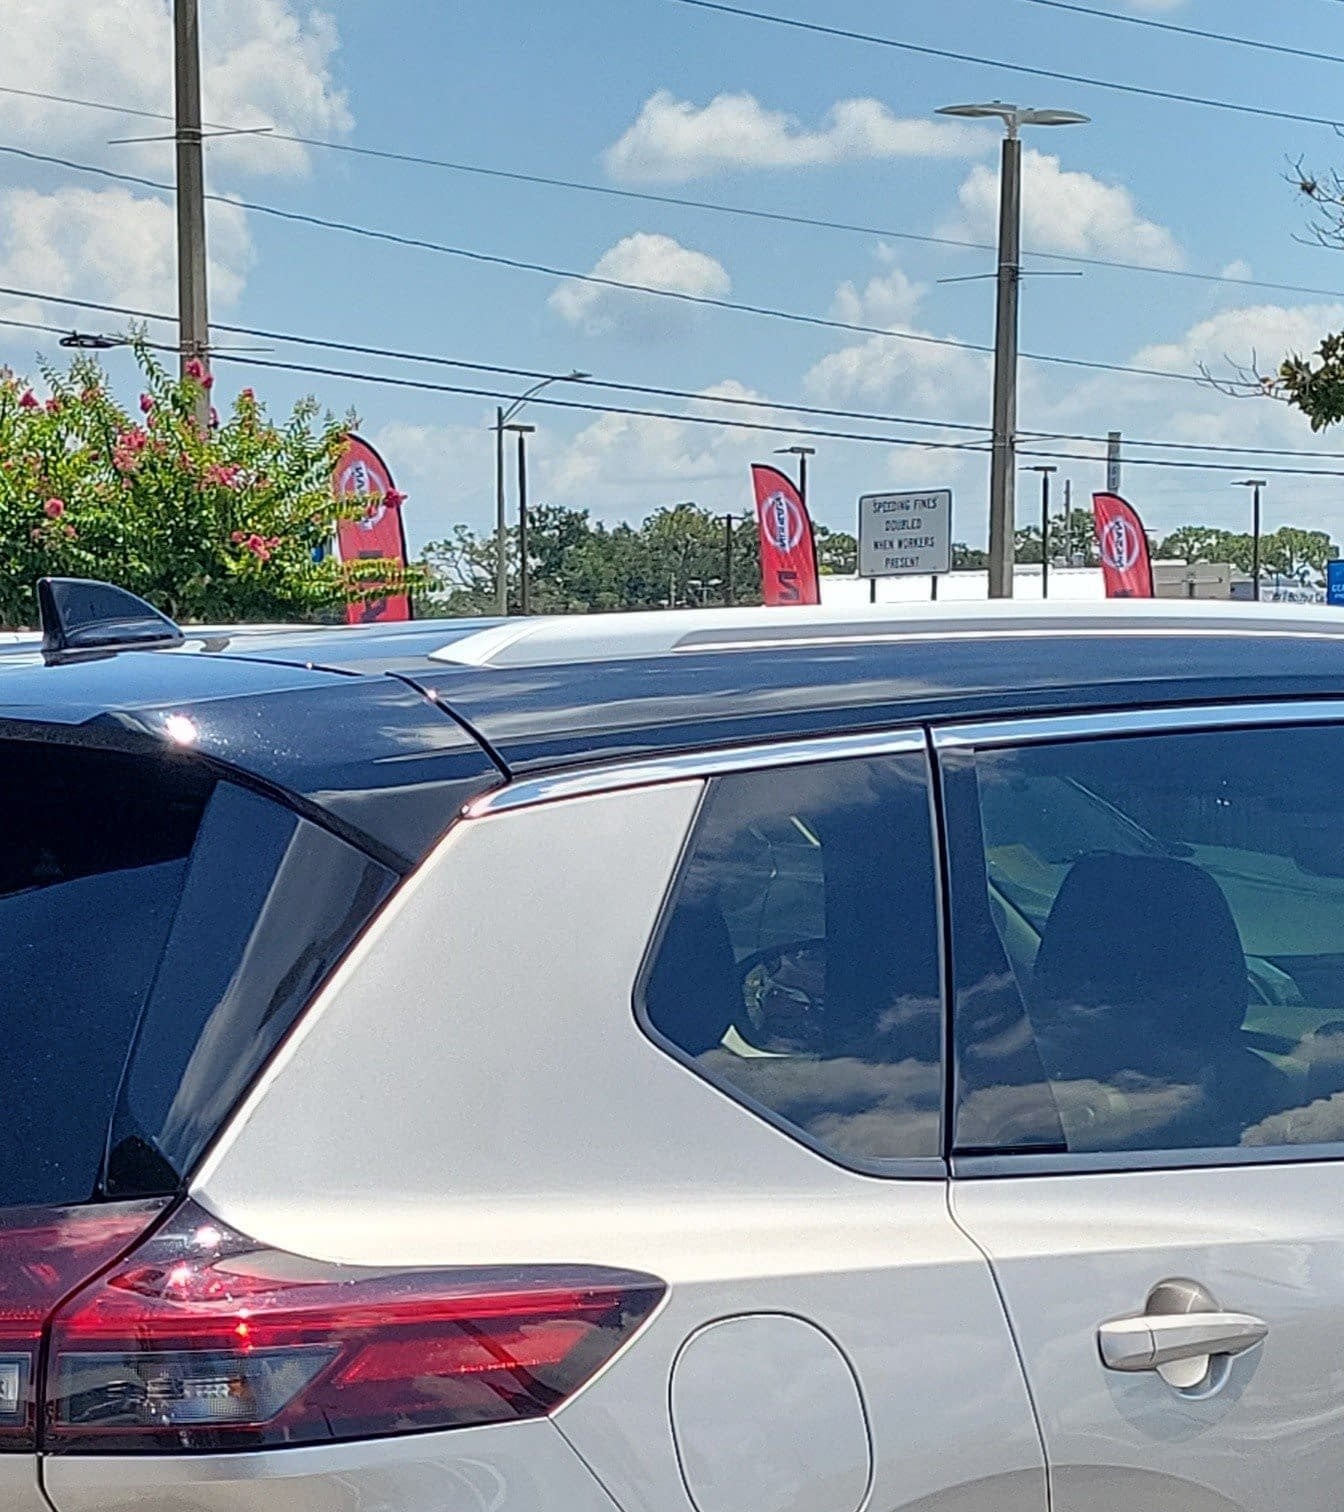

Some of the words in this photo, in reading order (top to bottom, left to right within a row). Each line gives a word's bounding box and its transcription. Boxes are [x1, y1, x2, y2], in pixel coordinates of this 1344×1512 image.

[872, 499, 910, 514] SPEEDING
[914, 496, 938, 510] FINES
[885, 518, 922, 532] DOUBLED
[873, 539, 894, 550] WHEN
[898, 536, 935, 549] WORKERS
[885, 556, 919, 569] PRESENT
